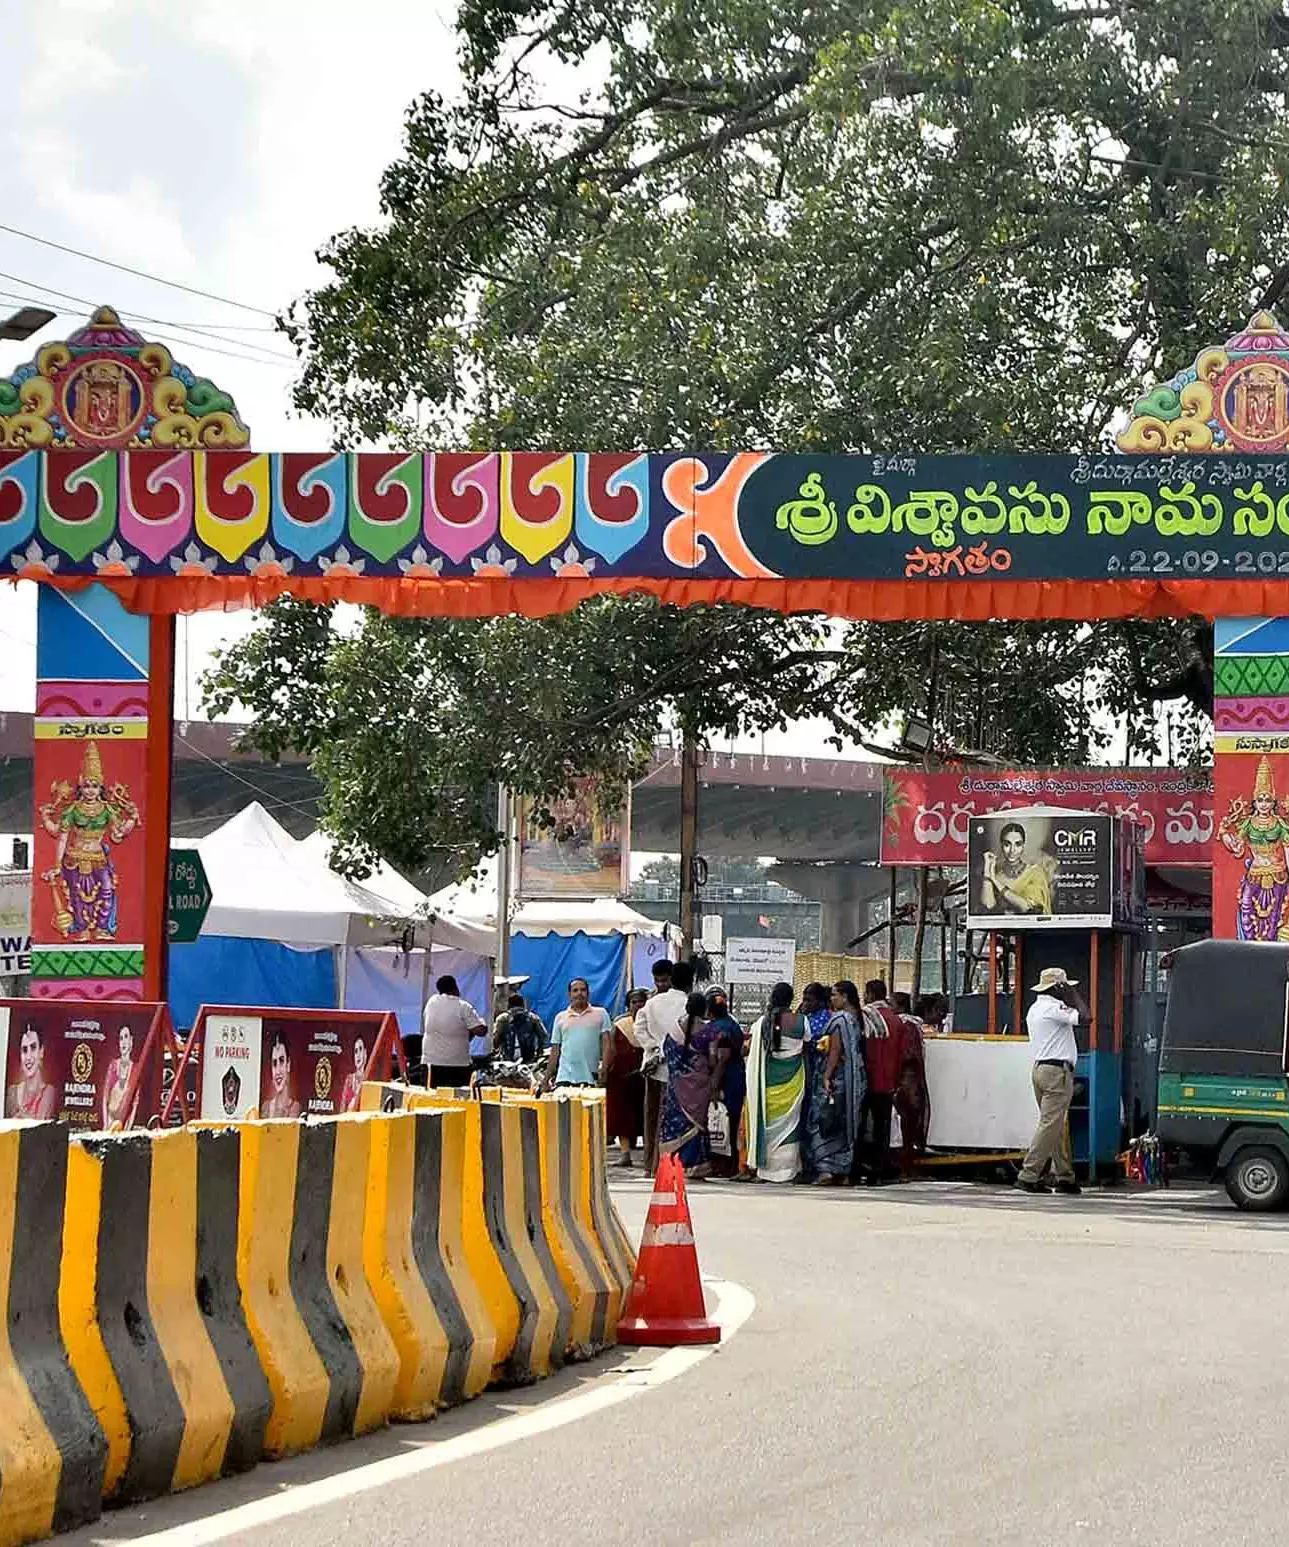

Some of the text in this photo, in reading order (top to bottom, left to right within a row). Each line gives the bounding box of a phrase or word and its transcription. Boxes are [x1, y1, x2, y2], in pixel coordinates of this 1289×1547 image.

[775, 472, 838, 545] శ్రీ
[846, 480, 1071, 547] విశ్వావసు
[1087, 481, 1224, 536] నామ
[904, 541, 1012, 578] స్వాగతం
[1054, 827, 1097, 847] CMR
[175, 895, 201, 910] ROAD
